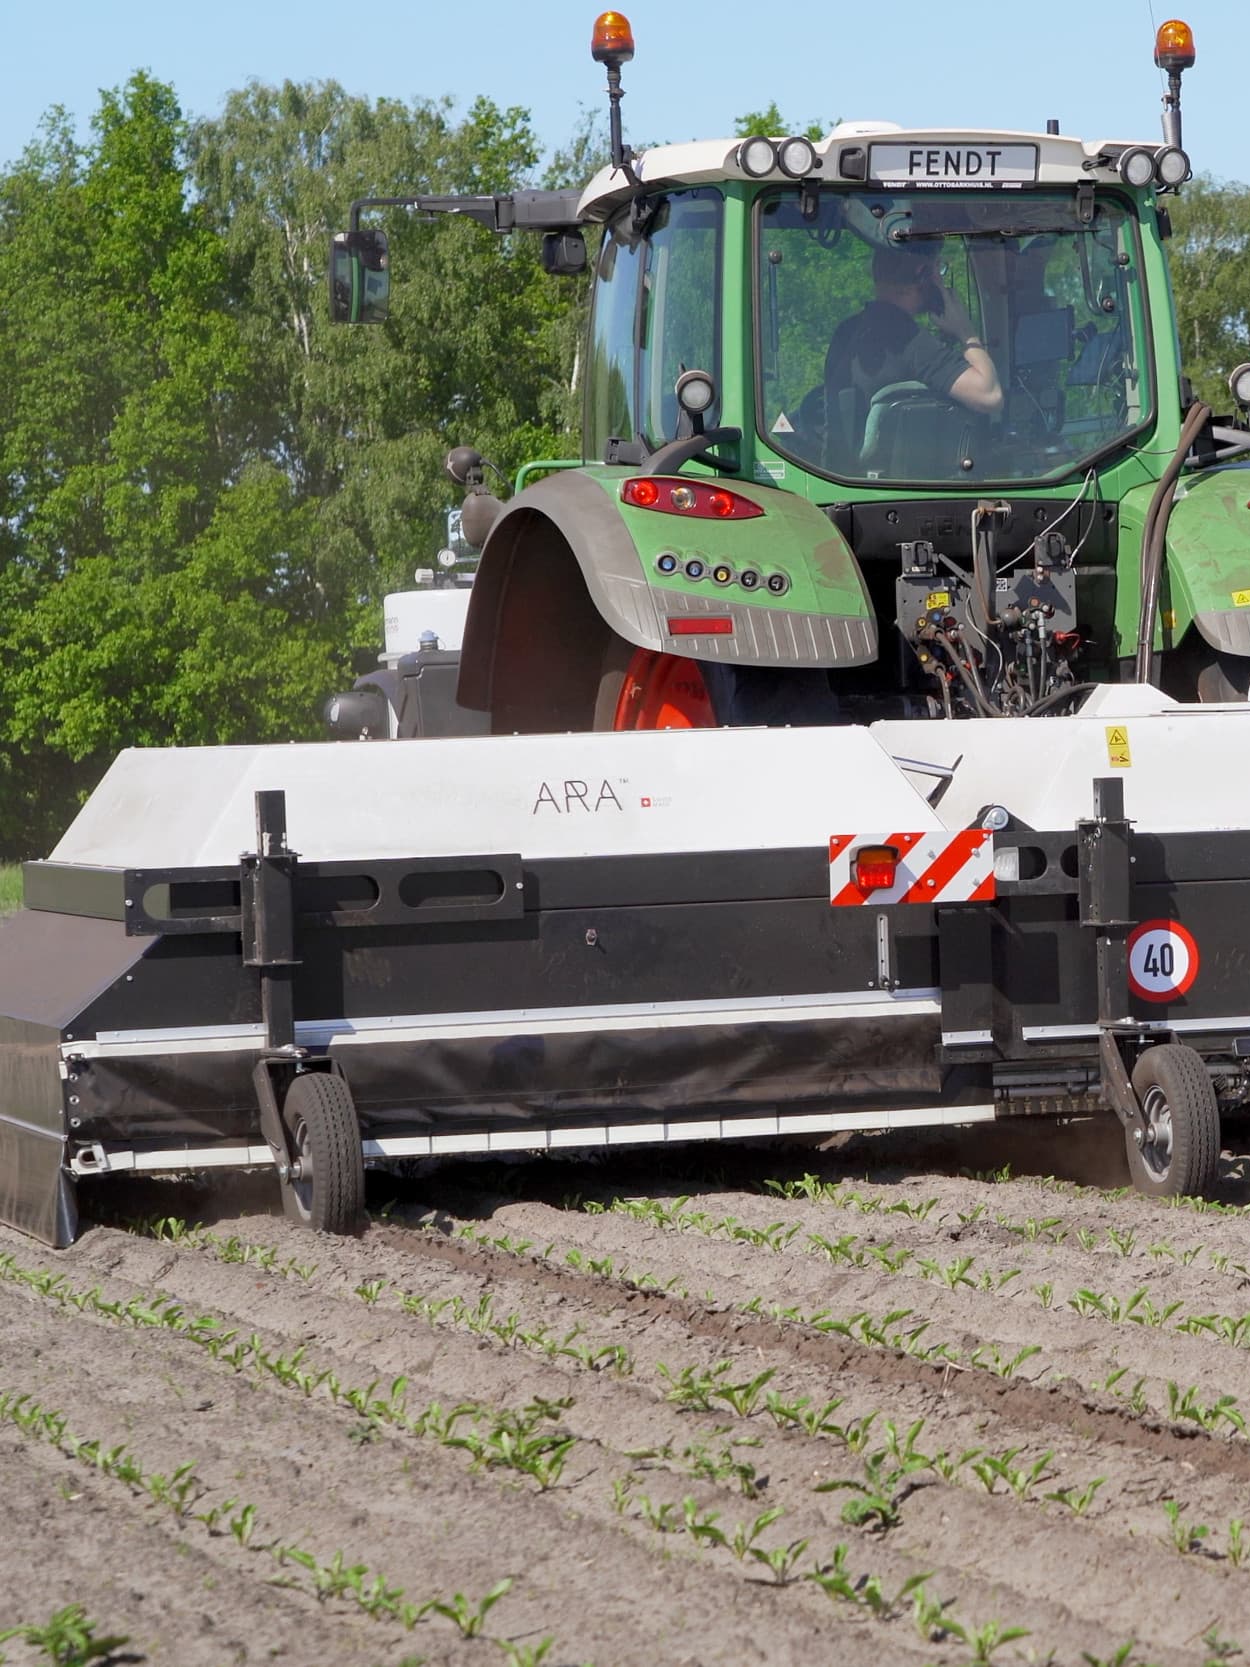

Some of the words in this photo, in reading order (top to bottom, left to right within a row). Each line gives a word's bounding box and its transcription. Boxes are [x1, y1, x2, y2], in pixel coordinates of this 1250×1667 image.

[909, 150, 1002, 176] FENDT
[533, 779, 624, 815] ARA
[1143, 942, 1175, 978] 40
